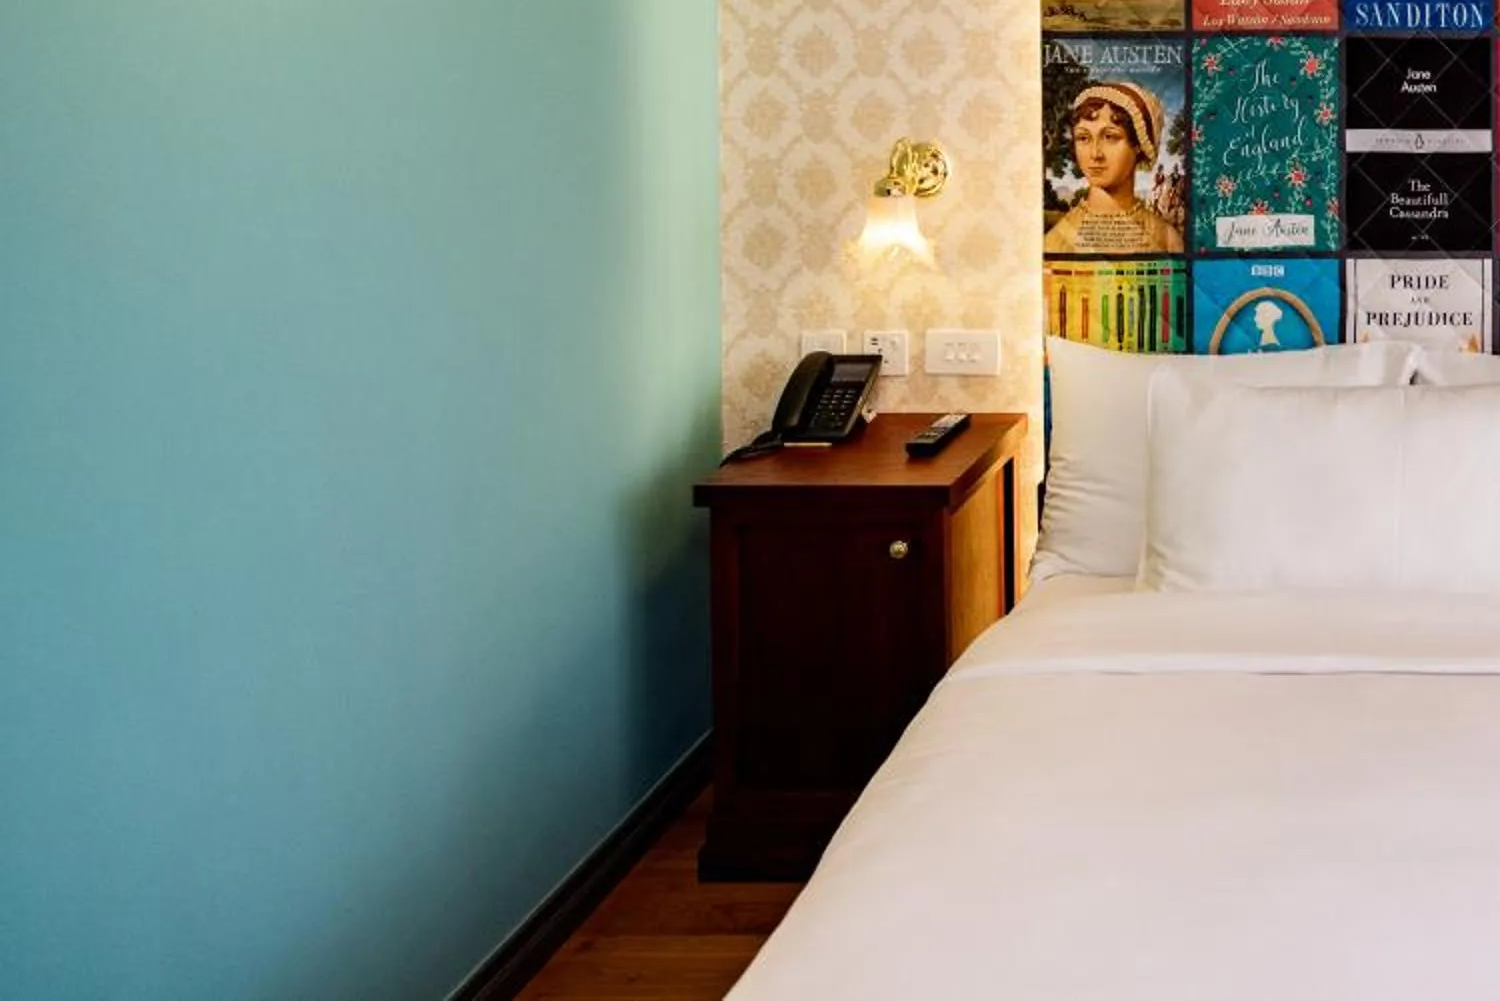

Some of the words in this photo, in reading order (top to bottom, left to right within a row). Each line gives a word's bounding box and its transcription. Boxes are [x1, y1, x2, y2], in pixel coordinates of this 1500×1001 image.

[1355, 1, 1484, 29] SANDITON
[1044, 44, 1093, 67] JANE
[1100, 44, 1182, 64] AUSTEN
[1251, 59, 1280, 92] The
[1406, 68, 1431, 80] Jane
[1401, 81, 1437, 94] Austen
[1223, 115, 1305, 170] England
[1408, 179, 1431, 192] The
[1390, 192, 1449, 206] Beautifull
[1389, 206, 1449, 219] Cassandra
[1226, 221, 1257, 245] Jane
[1265, 217, 1310, 237] Austen
[1251, 264, 1285, 277] BBC
[1390, 274, 1450, 290] PRIDE
[1366, 311, 1474, 327] PREJUDICE
